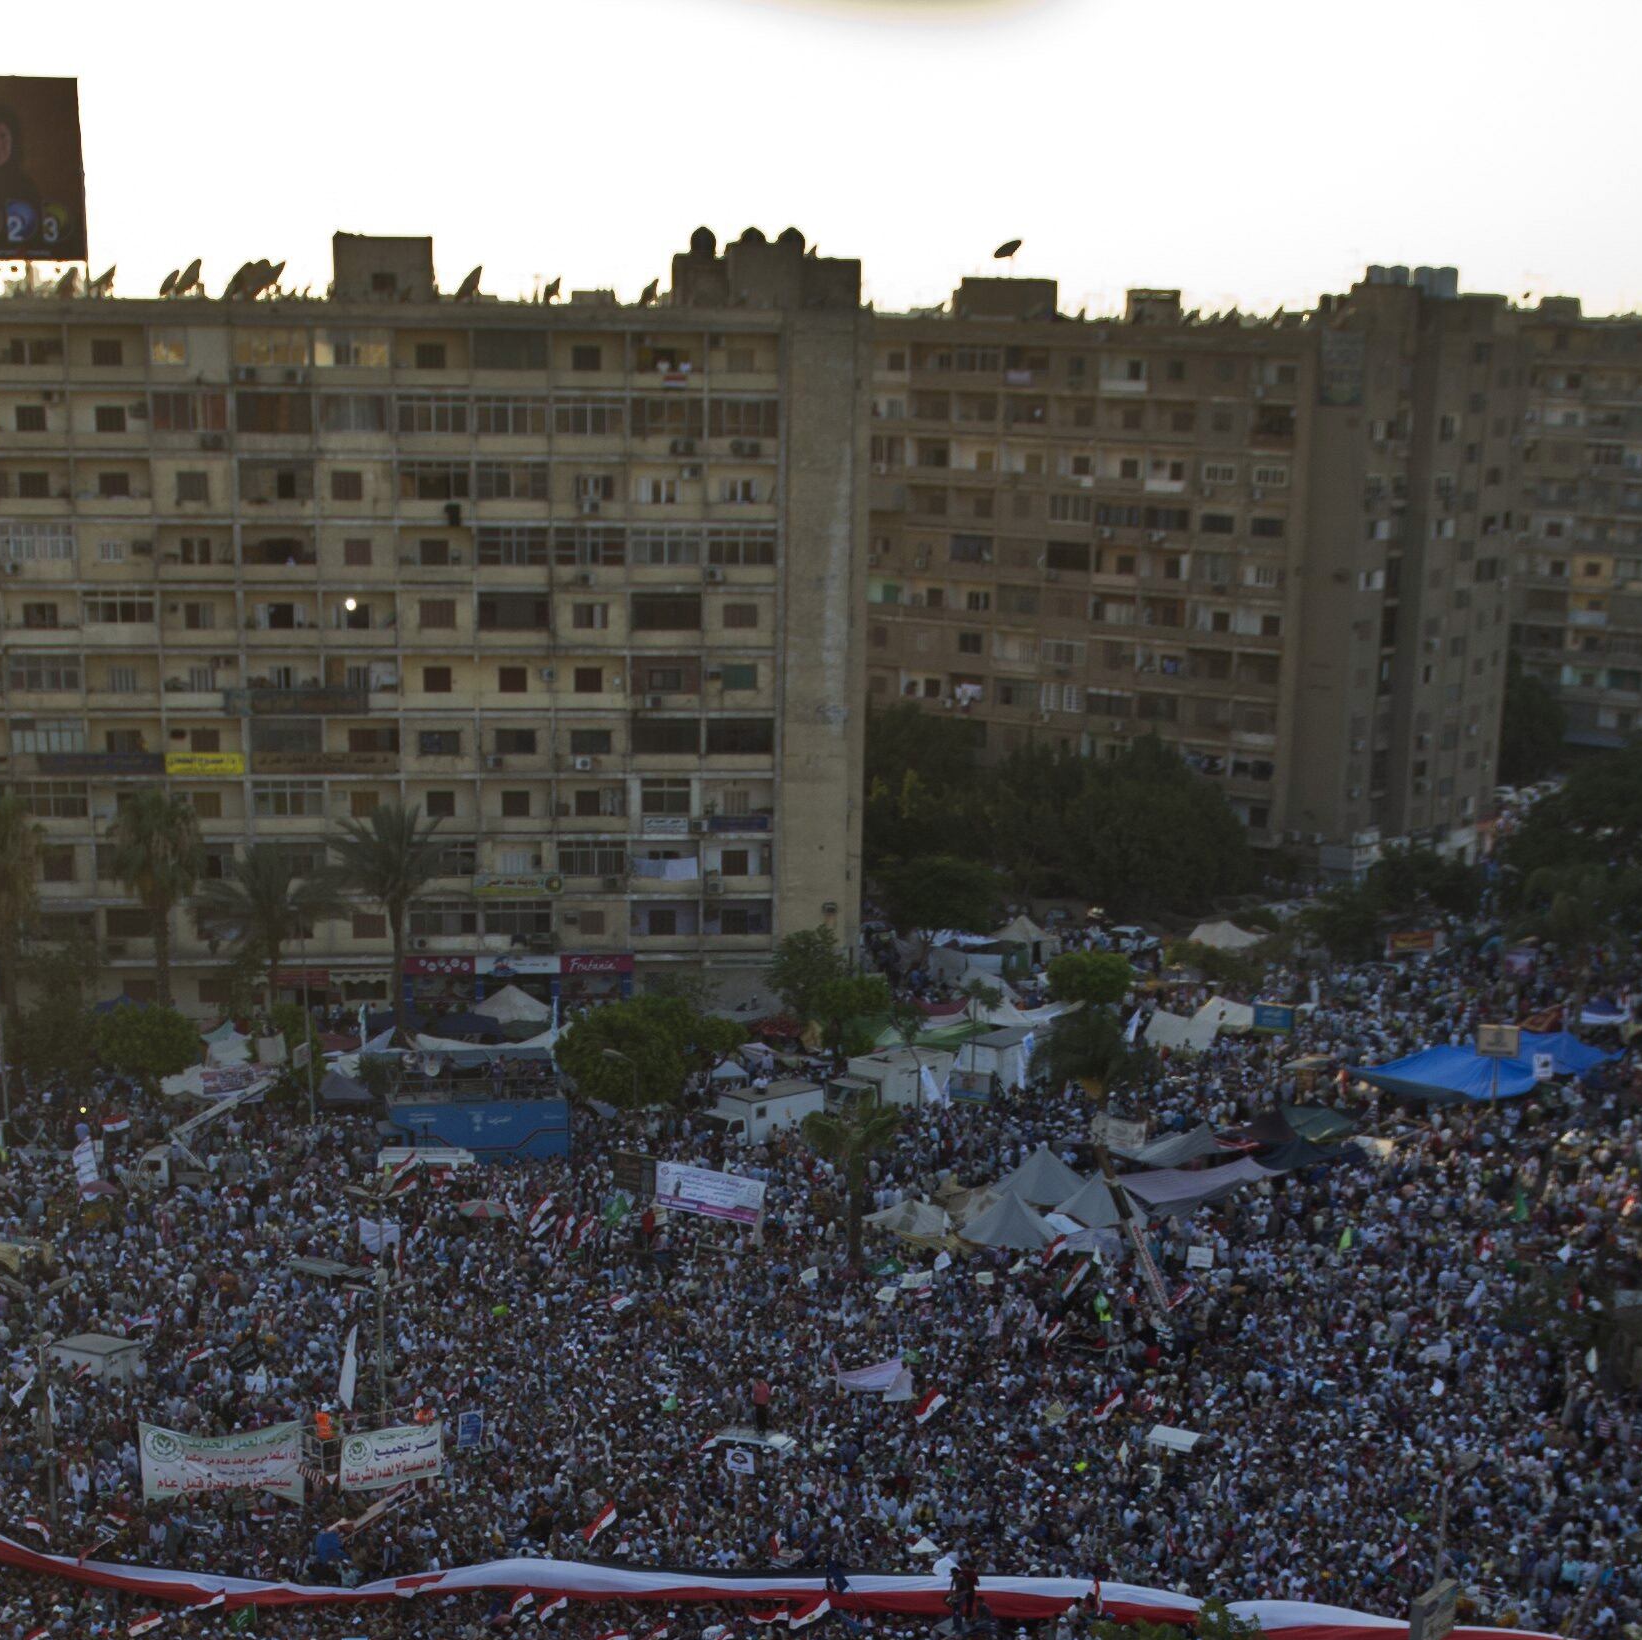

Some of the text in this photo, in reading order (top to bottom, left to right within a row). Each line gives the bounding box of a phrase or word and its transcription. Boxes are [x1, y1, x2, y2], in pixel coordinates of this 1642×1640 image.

[7, 215, 25, 242] 2
[42, 215, 59, 242] 3
[374, 1438, 438, 1461] مصر للجميع
